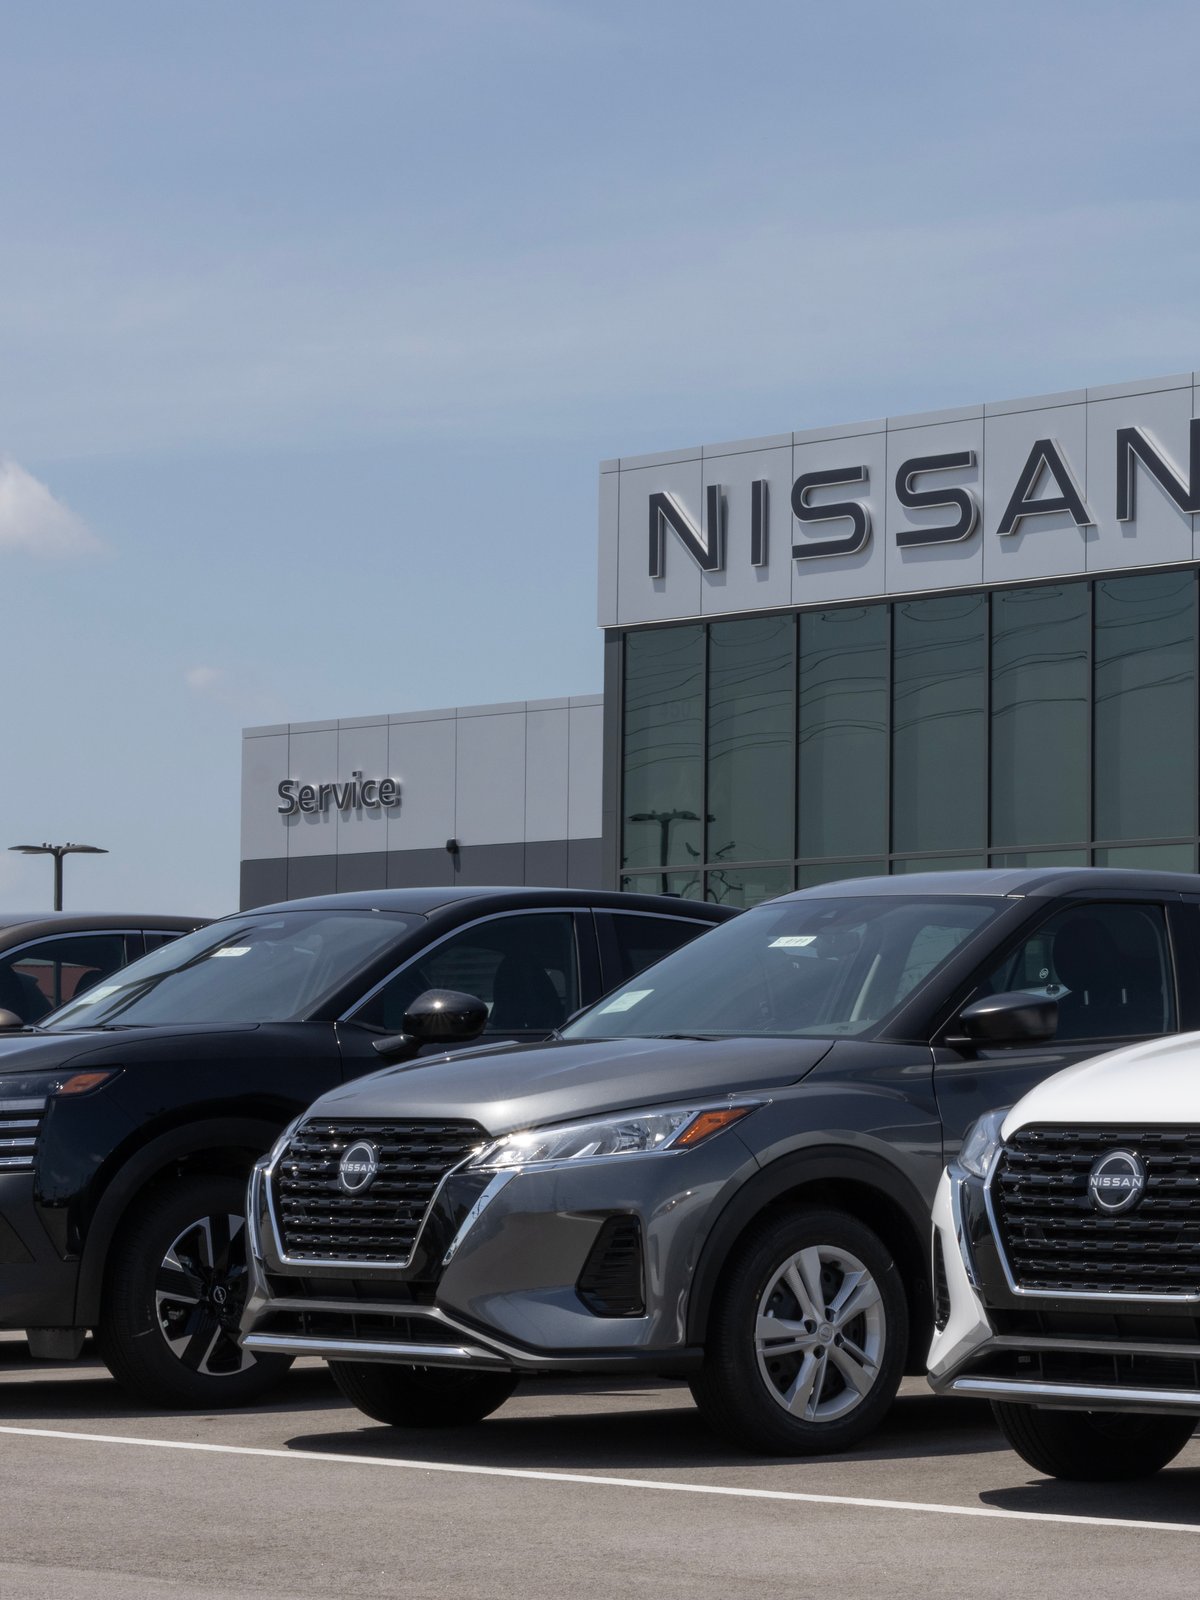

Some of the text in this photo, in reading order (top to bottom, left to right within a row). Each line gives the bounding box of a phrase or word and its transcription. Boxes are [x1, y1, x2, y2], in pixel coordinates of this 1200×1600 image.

[278, 770, 401, 815] Service
[339, 1163, 376, 1172] NISSAN
[1090, 1177, 1142, 1187] NISSAN
